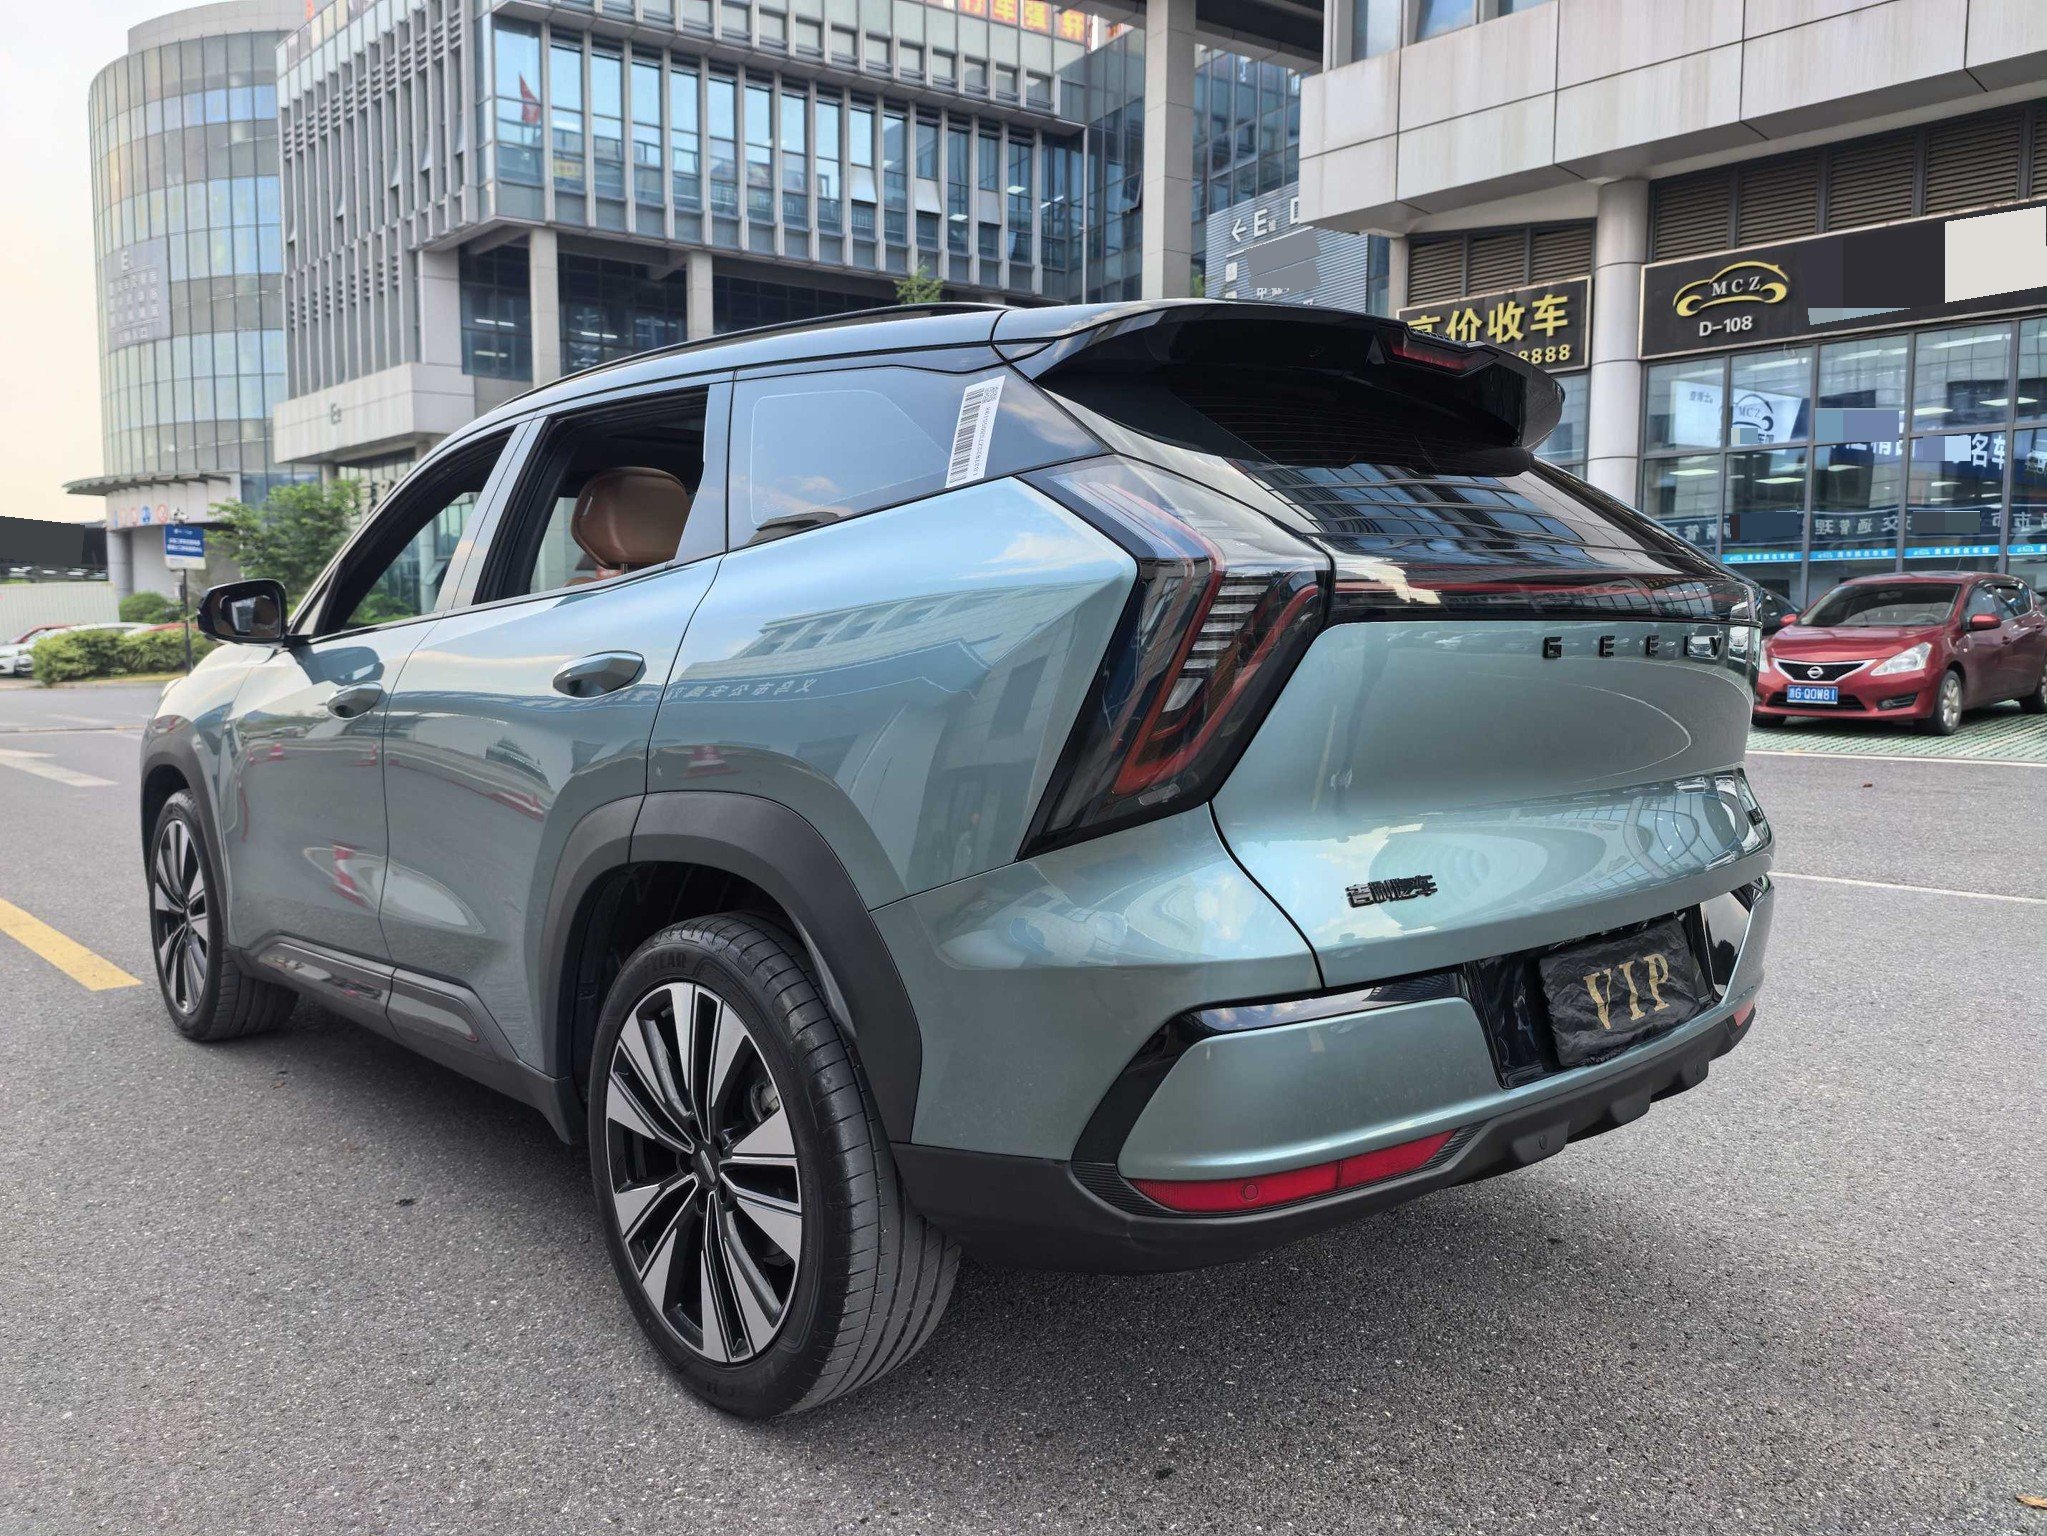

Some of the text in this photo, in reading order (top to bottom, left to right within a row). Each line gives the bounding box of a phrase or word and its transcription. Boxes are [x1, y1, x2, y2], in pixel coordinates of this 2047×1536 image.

[1711, 275, 1761, 297] MCZ
[1699, 315, 1753, 337] D-108
[1583, 953, 1670, 1030] VIP
